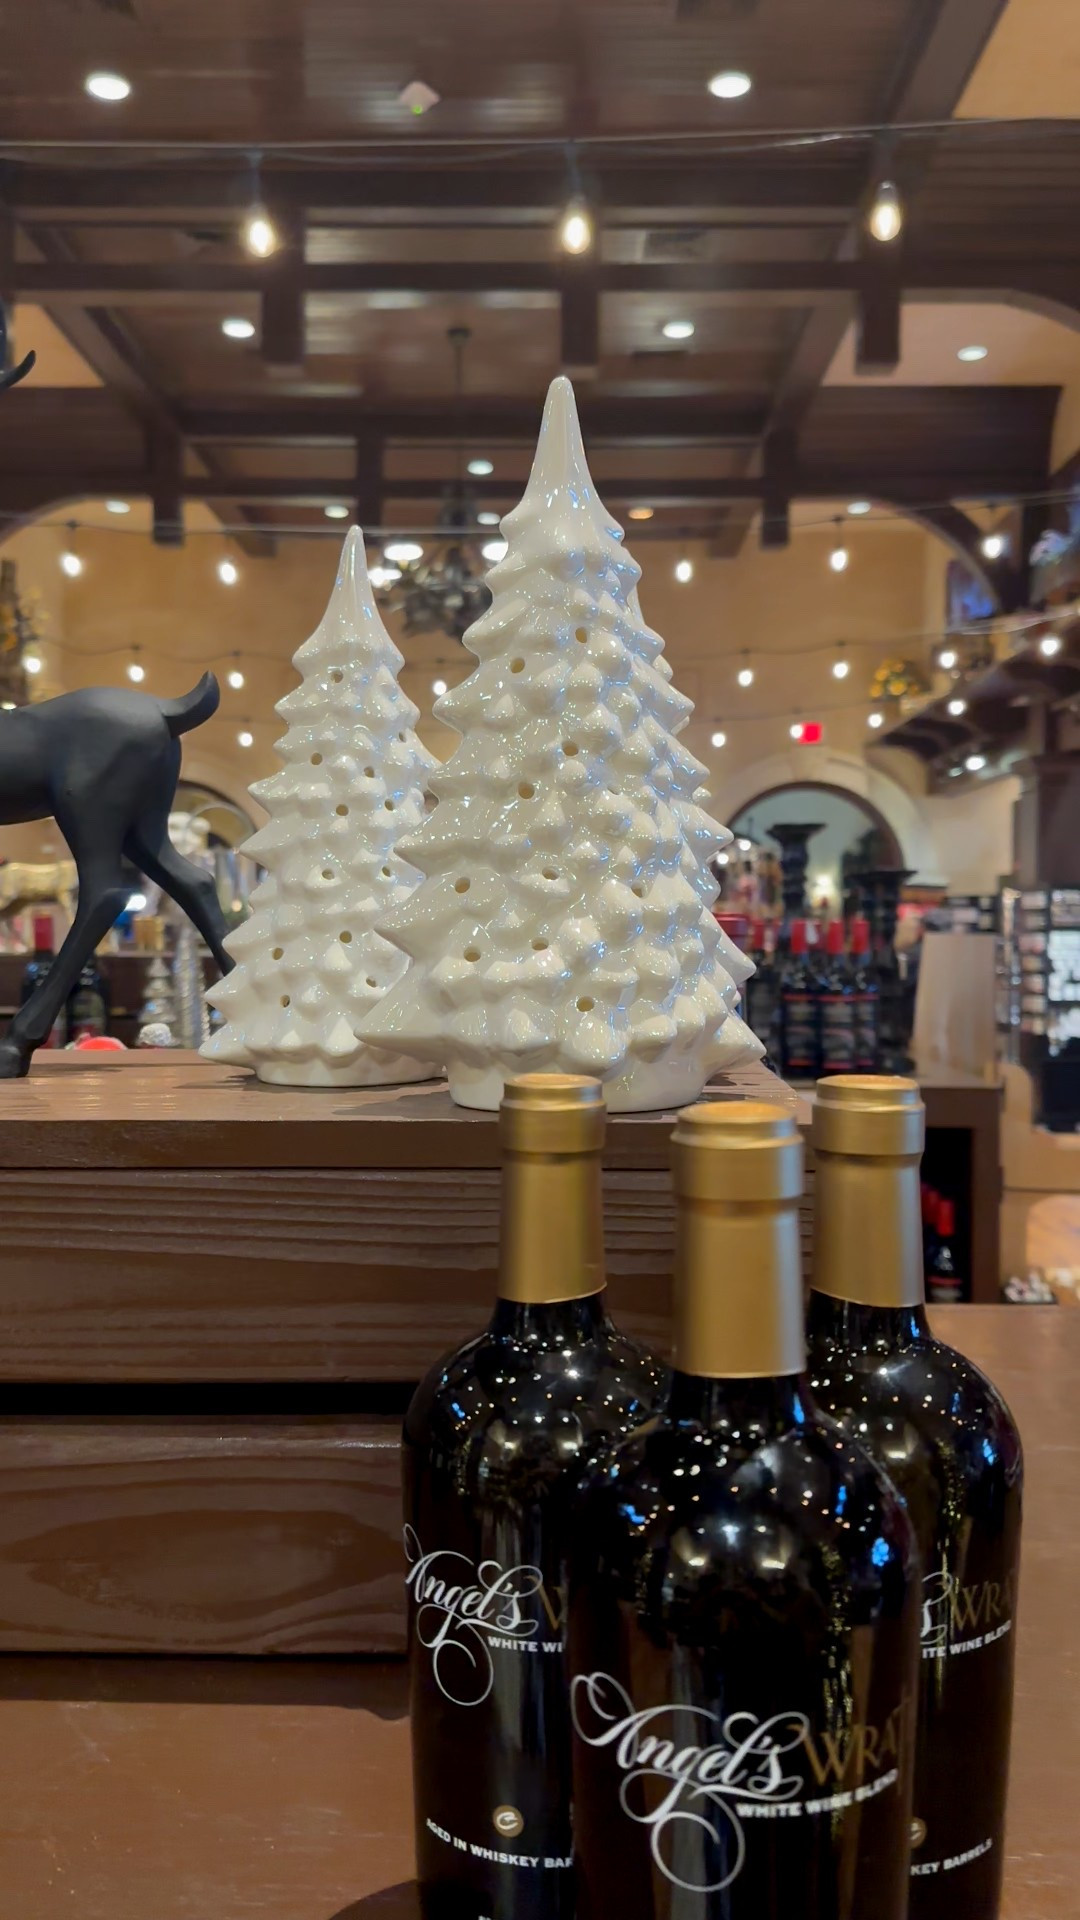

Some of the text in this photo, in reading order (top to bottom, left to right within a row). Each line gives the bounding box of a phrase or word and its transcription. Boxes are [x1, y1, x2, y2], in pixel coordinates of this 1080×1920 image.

[403, 1523, 543, 1706] Angel's
[487, 1636, 538, 1653] WHITE
[949, 1636, 983, 1655] WINE
[570, 1671, 810, 1892] Angel's
[734, 1767, 898, 1818] WHITE WINE BLEND
[453, 1836, 467, 1851] IN
[470, 1843, 540, 1868] WHISKEY
[943, 1838, 992, 1870] BARRELS
